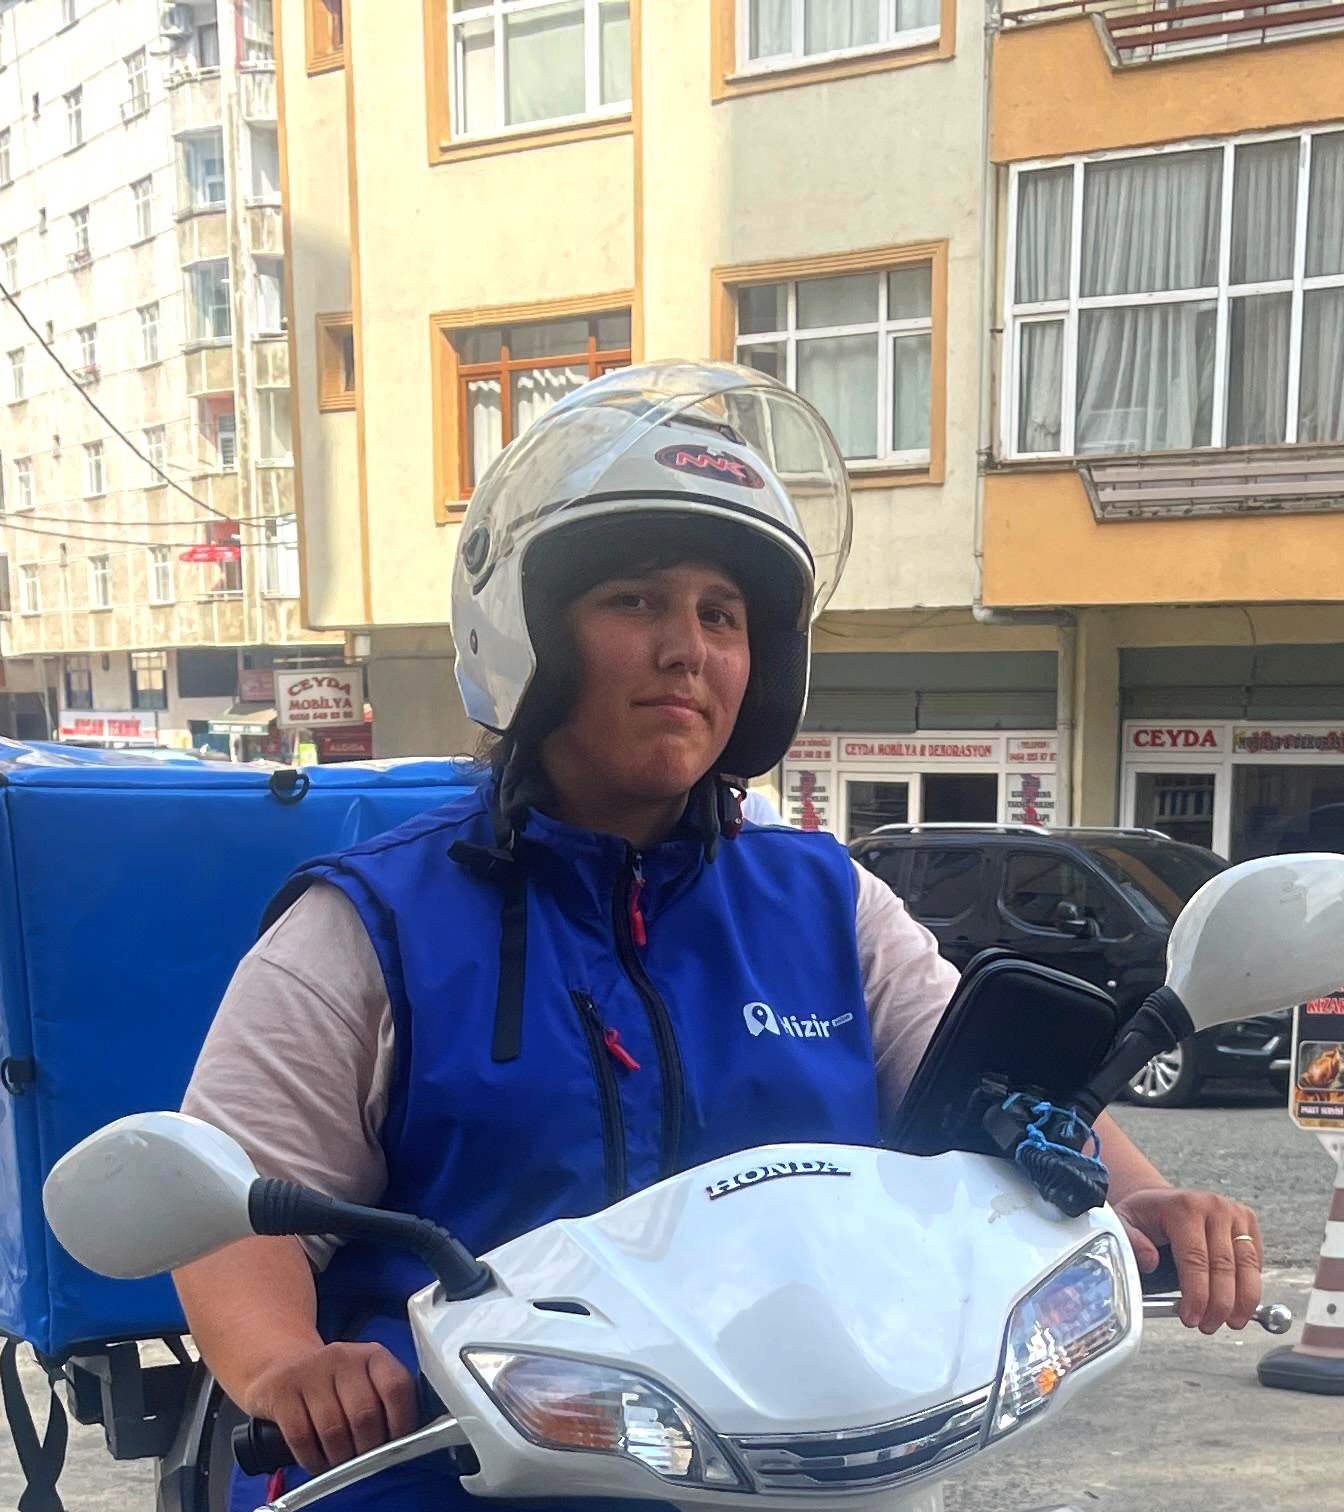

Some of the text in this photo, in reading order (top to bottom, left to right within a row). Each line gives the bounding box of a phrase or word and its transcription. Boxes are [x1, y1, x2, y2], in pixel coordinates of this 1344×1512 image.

[287, 676, 352, 696] CEYDA
[288, 695, 353, 710] MOBİLYA
[1132, 729, 1218, 748] CEYDA
[845, 743, 875, 756] CEYDA
[878, 740, 917, 756] MOBİLYA
[928, 743, 992, 757] DEKORASYON
[706, 1160, 851, 1200] HONDA
